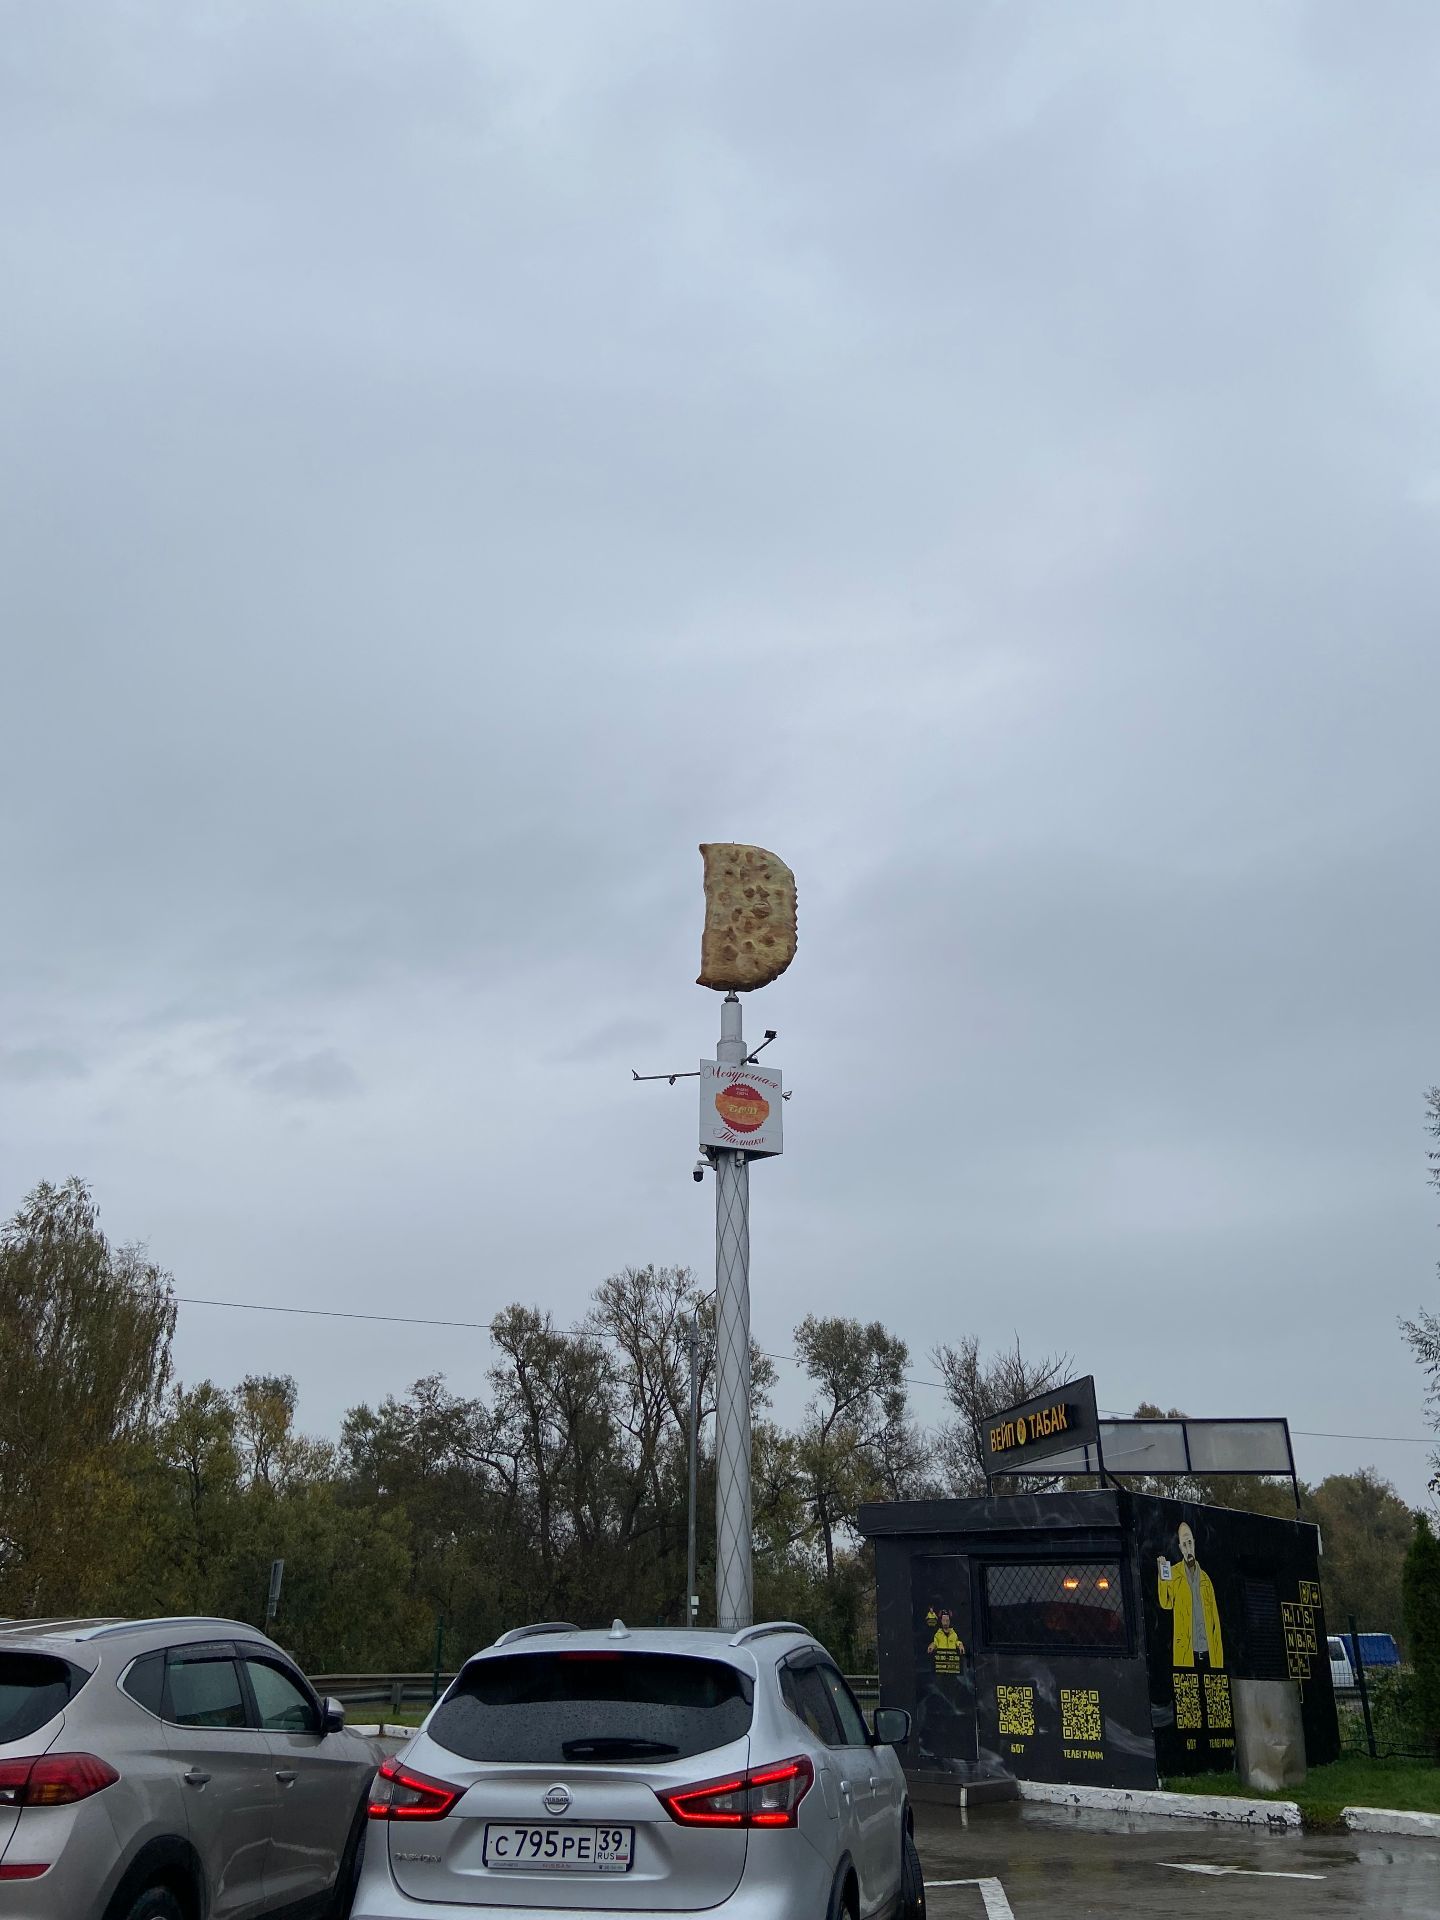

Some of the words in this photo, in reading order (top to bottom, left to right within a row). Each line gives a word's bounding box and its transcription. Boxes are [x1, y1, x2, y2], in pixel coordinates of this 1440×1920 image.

[990, 1421, 1015, 1452] ВЕЙП
[1029, 1403, 1067, 1439] ТАБАК
[1010, 1743, 1025, 1754] БОТ
[1063, 1749, 1104, 1760] ТЕЛЕГРАММ
[598, 1830, 623, 1852] 39
[597, 1852, 615, 1860] RUS
